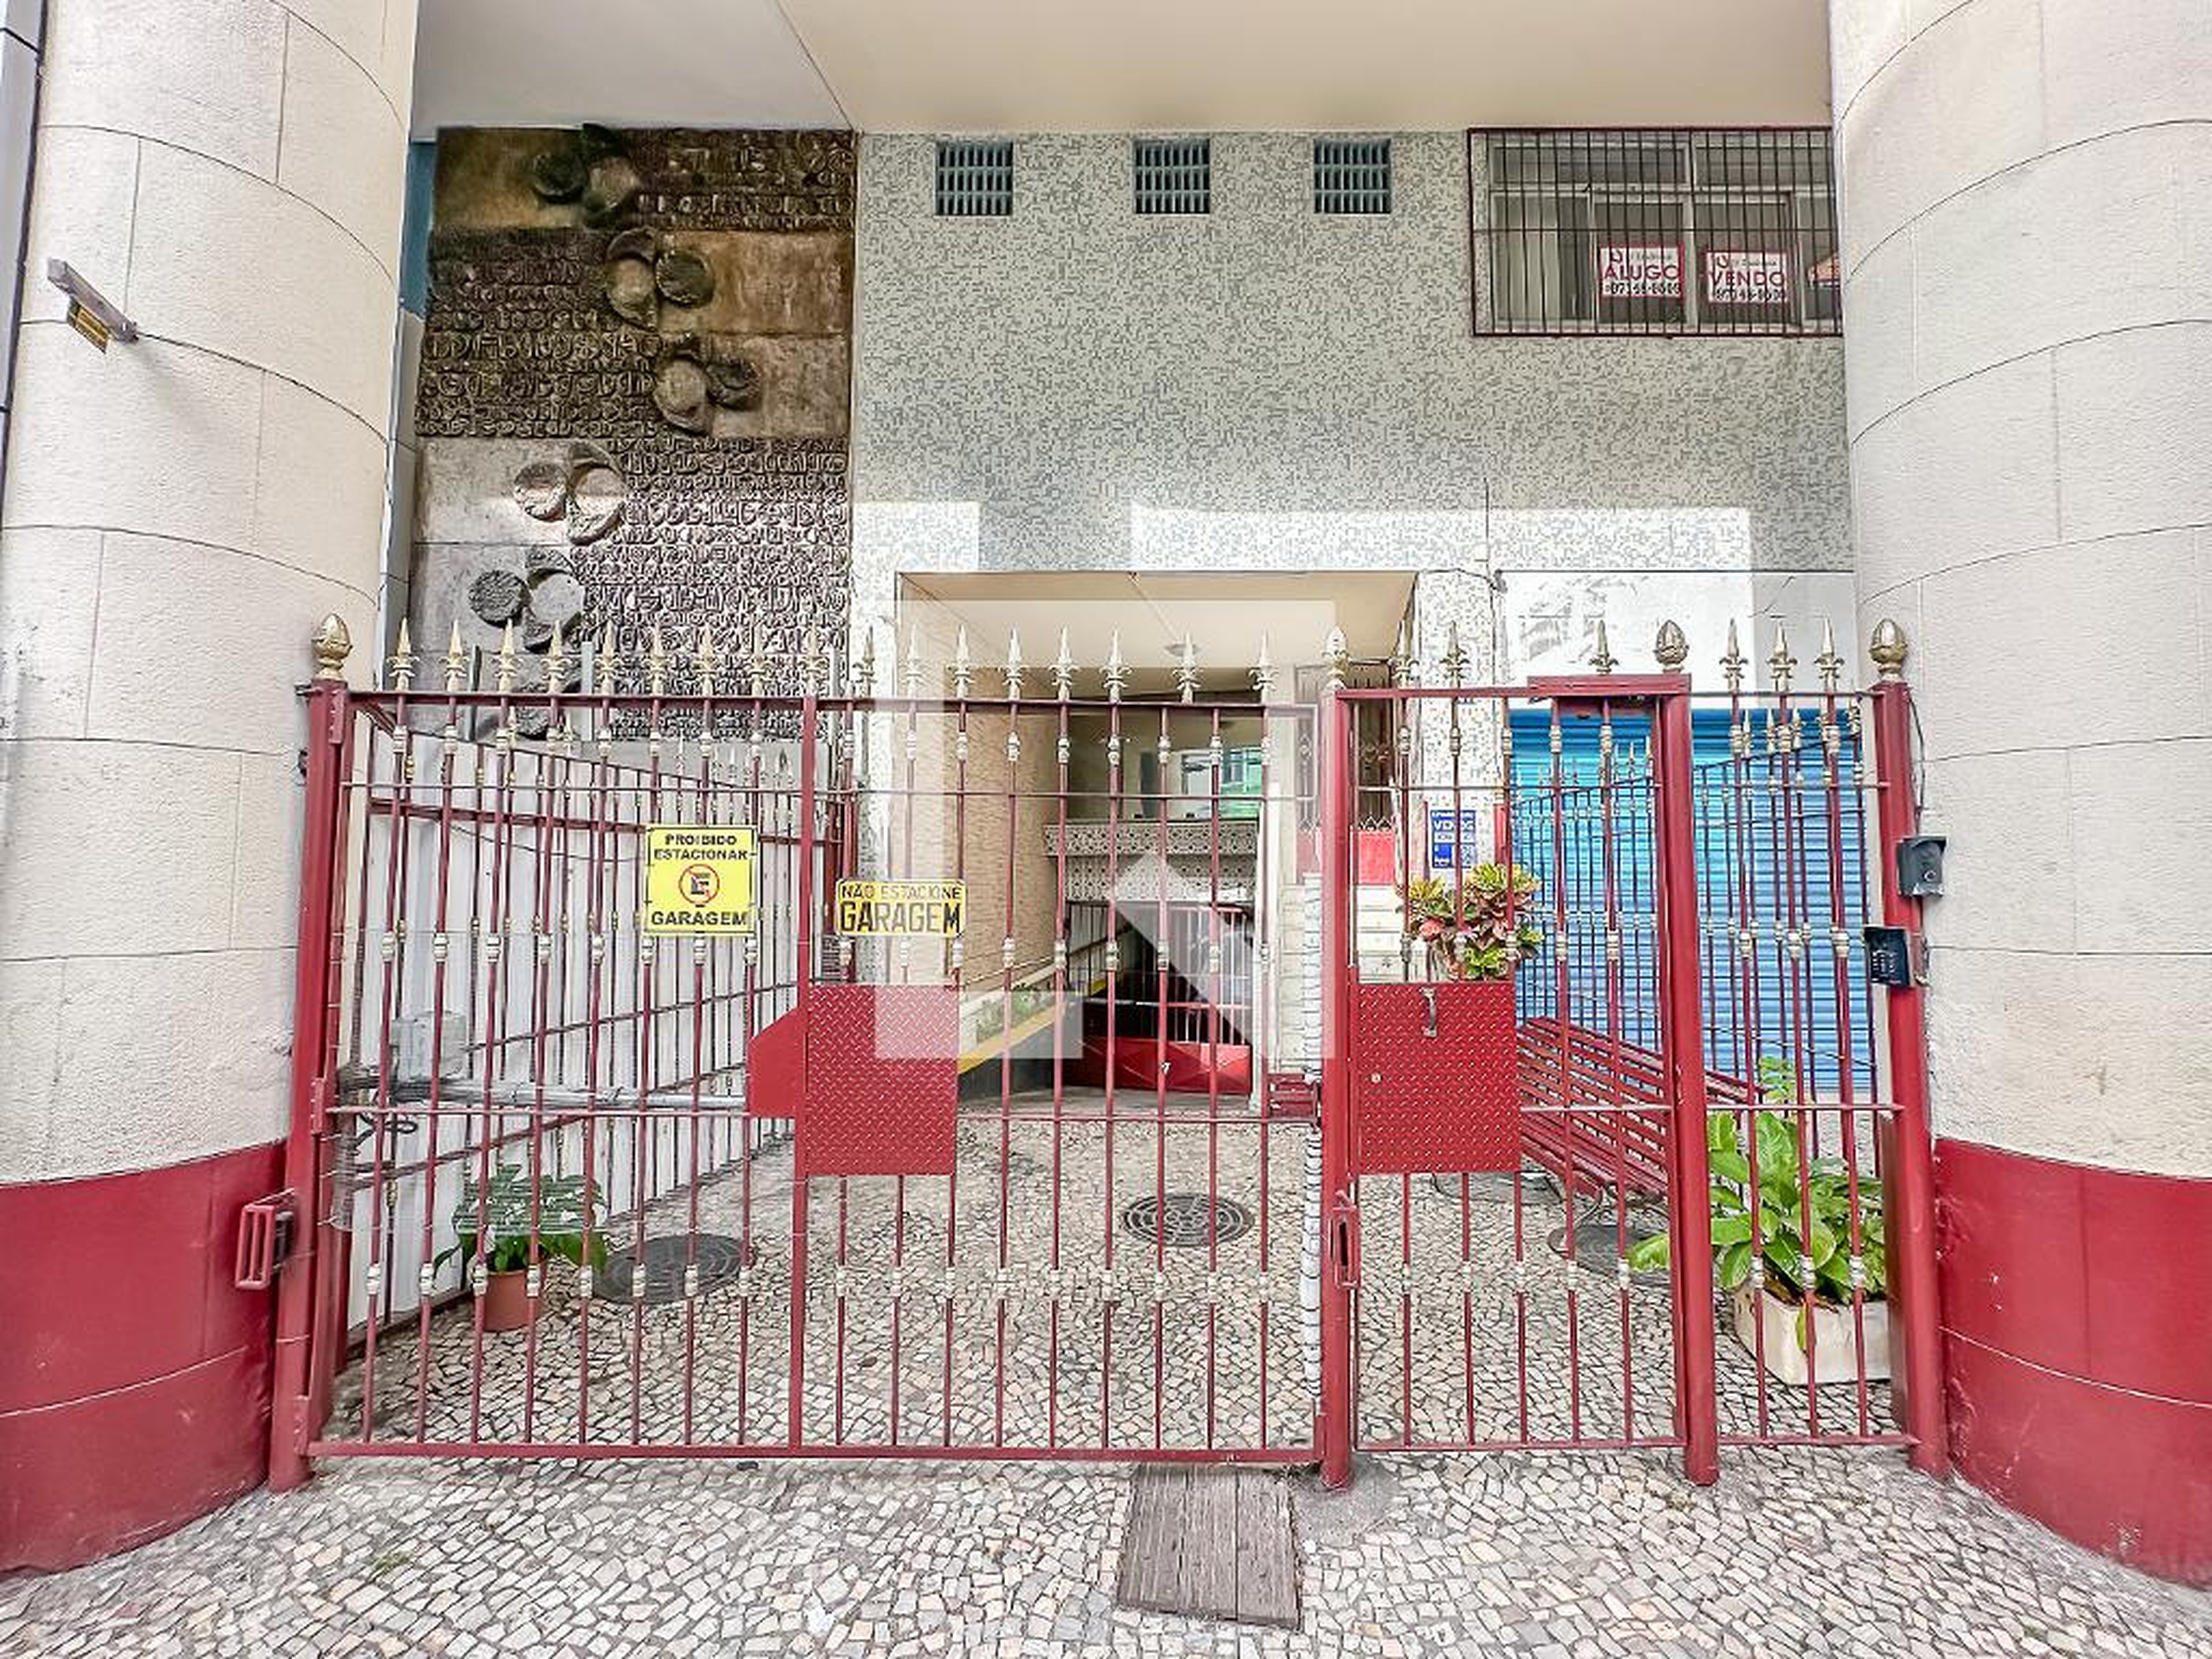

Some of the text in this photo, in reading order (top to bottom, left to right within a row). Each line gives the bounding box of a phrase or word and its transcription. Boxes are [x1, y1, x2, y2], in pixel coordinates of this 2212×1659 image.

[1604, 264, 1680, 280] ALUGO
[1712, 271, 1785, 286] VENDO
[665, 834, 737, 845] PROIBIDO
[654, 849, 748, 860] ESTACIONAR
[842, 883, 961, 899] NÃO ESTACIONE
[651, 911, 747, 925] GARAGEM
[840, 902, 960, 933] GARAGEM
